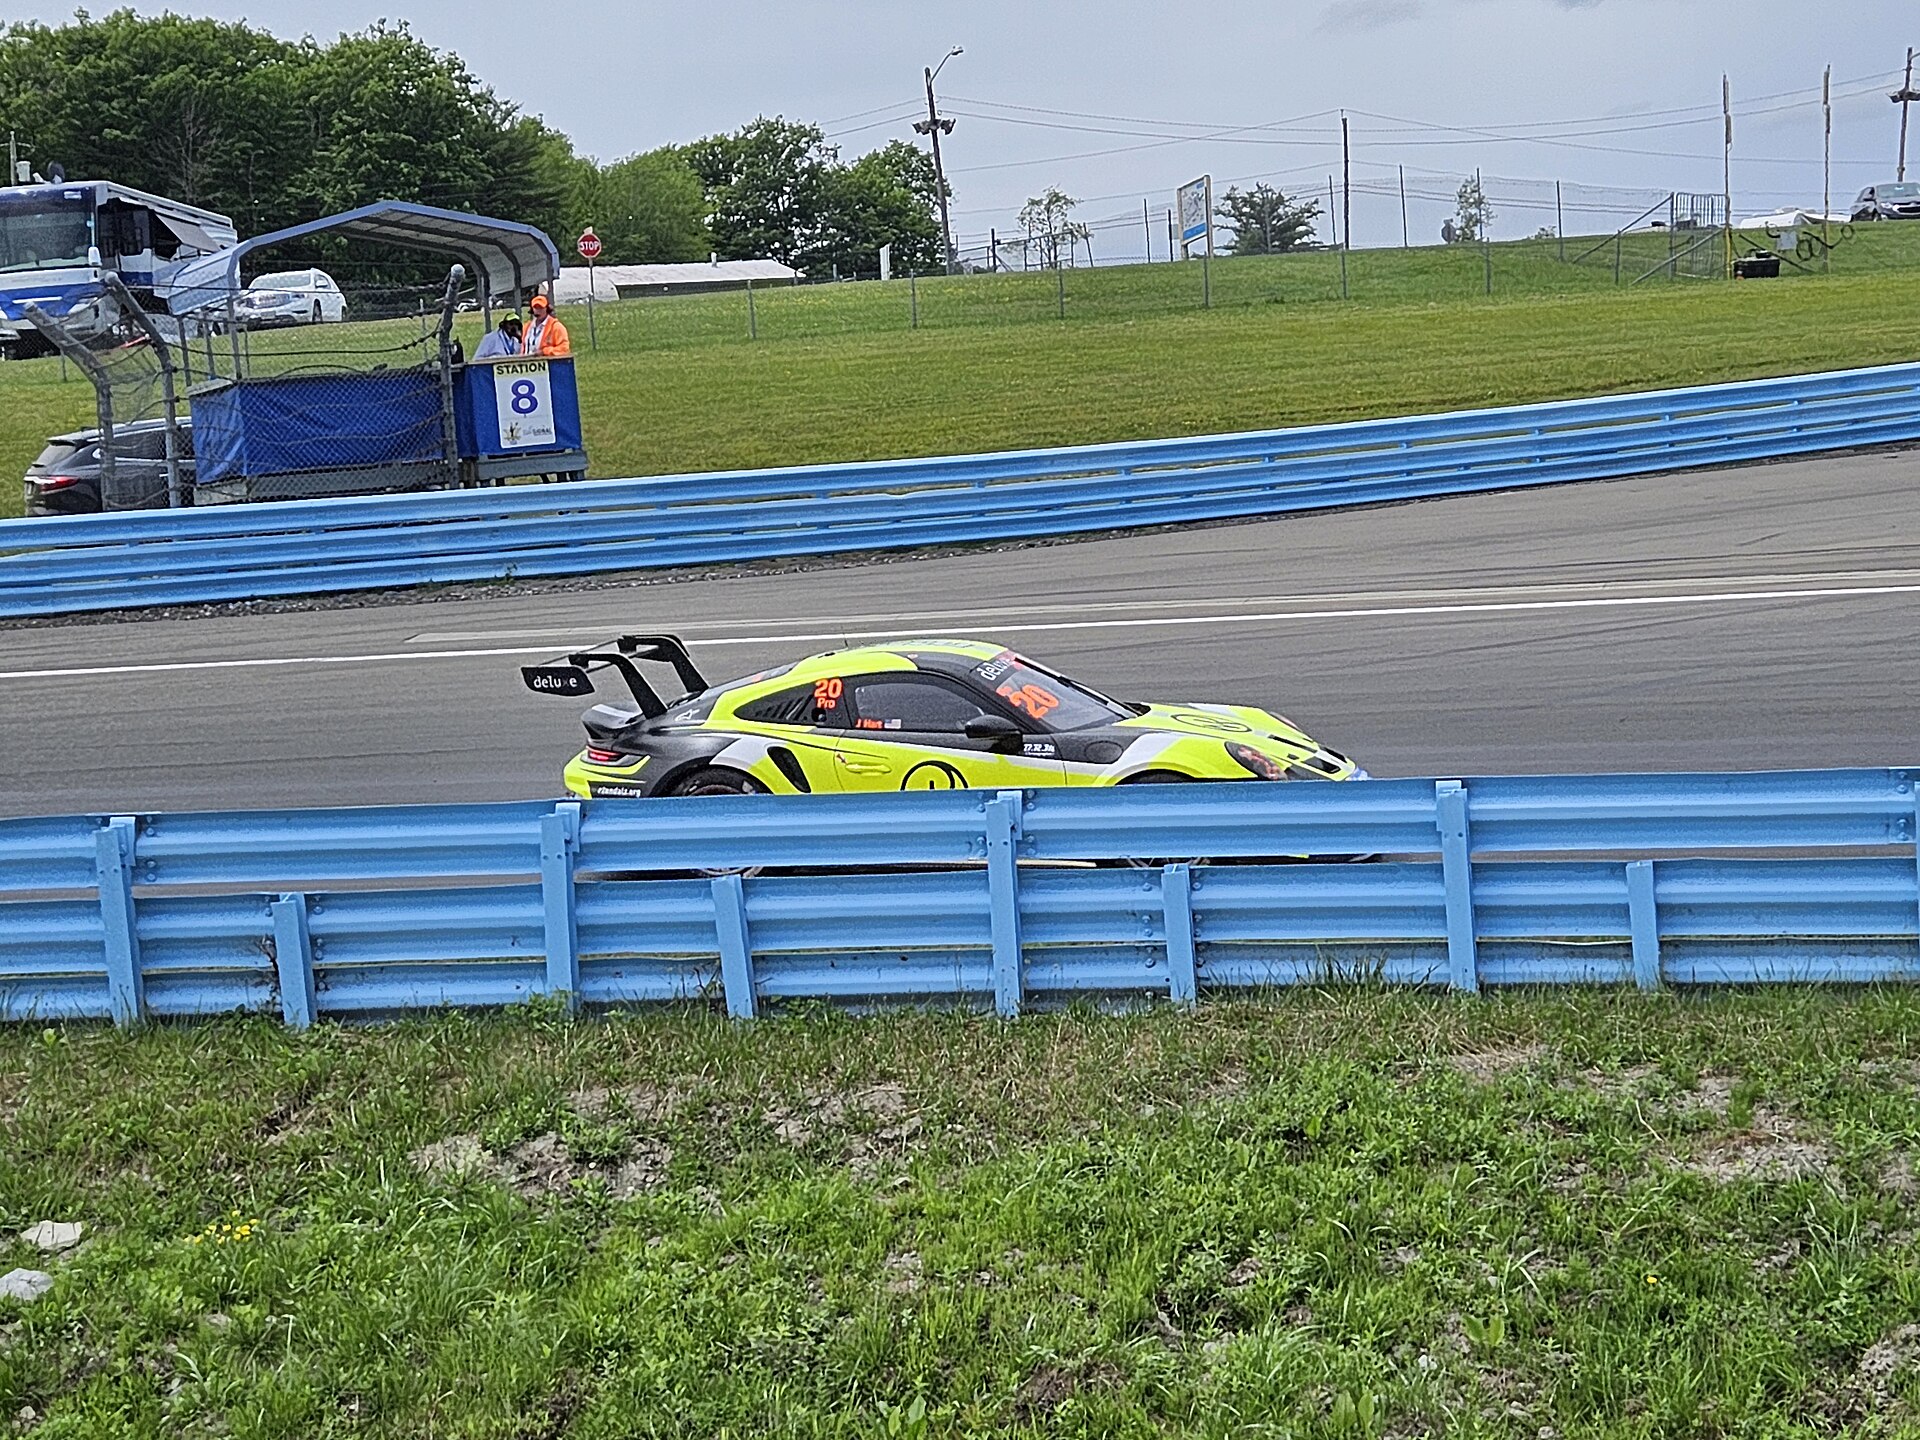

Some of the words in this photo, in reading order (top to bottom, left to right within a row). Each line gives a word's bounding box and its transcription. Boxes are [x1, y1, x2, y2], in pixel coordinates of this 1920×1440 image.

[580, 241, 600, 251] STOP
[496, 362, 546, 375] STATION
[511, 379, 538, 414] 8
[533, 675, 578, 689] deluxe
[814, 678, 842, 699] 20
[817, 697, 836, 709] Pro
[1009, 684, 1059, 719] 20
